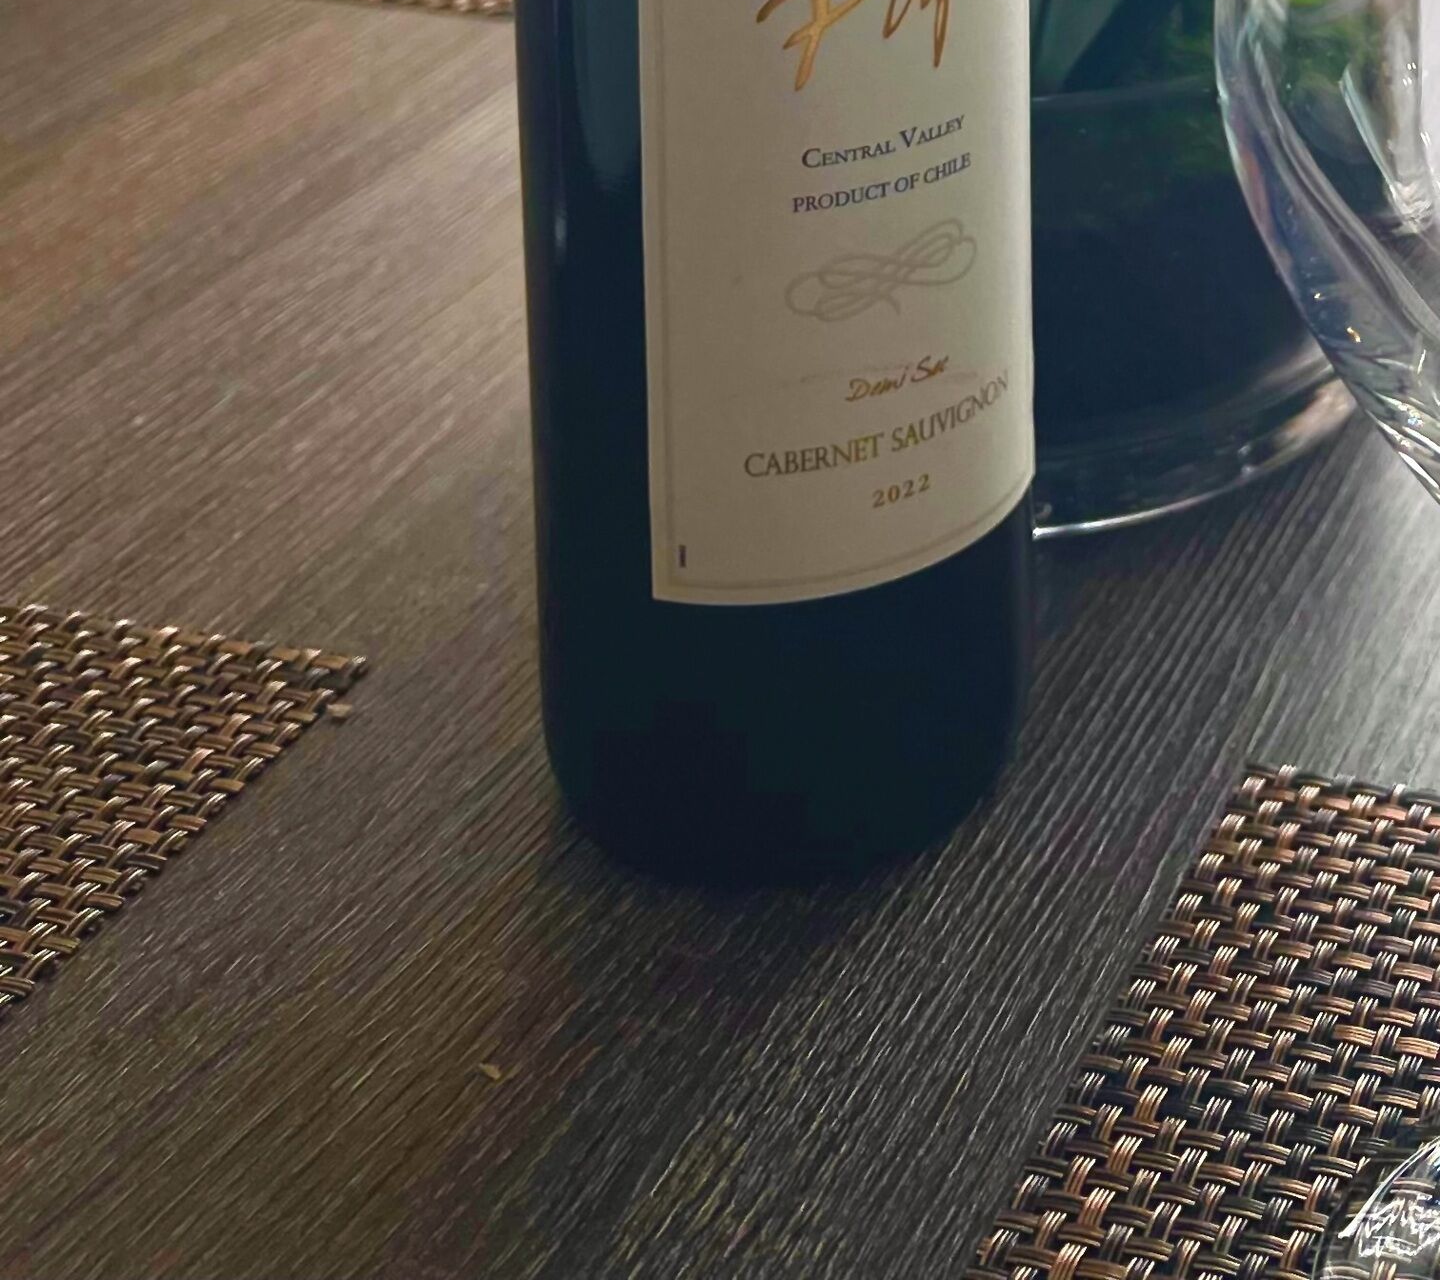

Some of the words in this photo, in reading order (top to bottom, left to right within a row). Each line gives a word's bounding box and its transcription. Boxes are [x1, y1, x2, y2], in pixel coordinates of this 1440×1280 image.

[792, 181, 891, 213] PRODUCT
[894, 173, 921, 192] OF
[923, 152, 972, 184] CHILE
[744, 432, 885, 478] CABERNET
[891, 369, 1010, 452] SAUVIGNON
[872, 473, 931, 509] 2022
